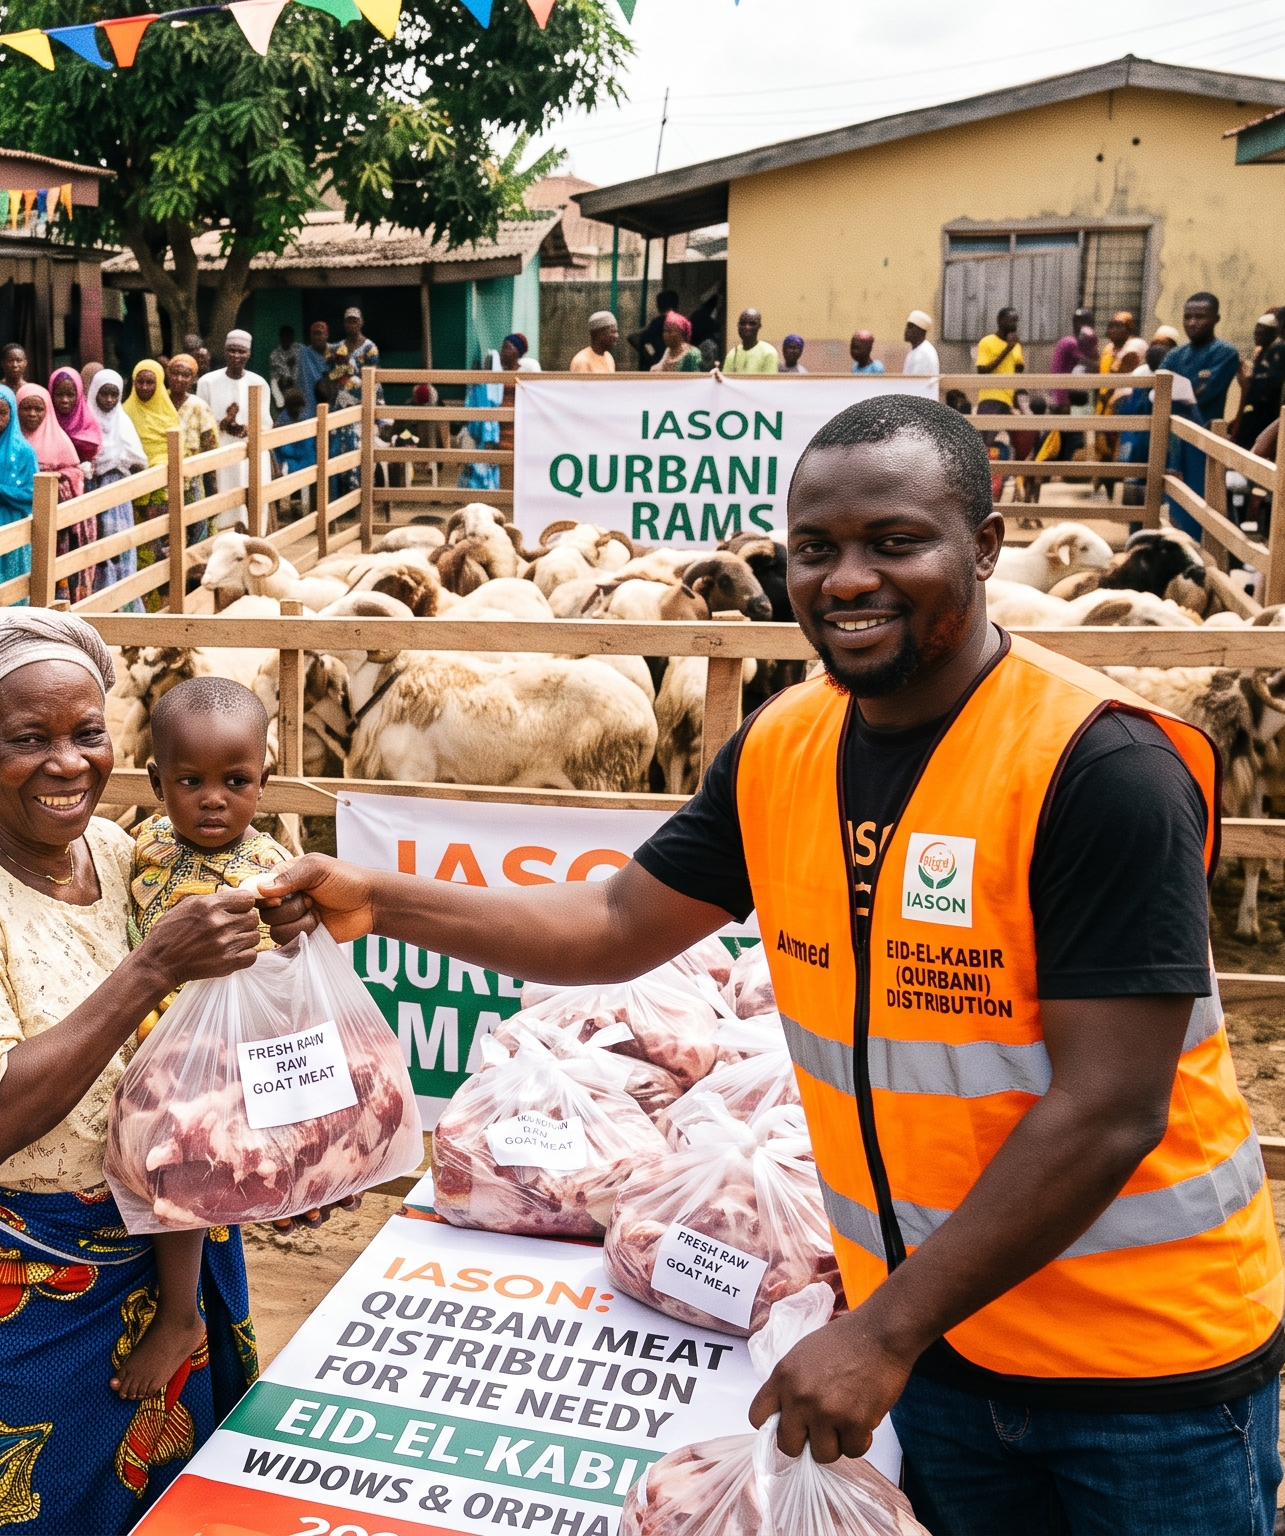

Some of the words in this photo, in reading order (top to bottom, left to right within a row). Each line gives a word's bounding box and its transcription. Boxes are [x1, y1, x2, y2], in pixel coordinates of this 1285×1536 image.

[641, 410, 783, 440] IASON
[549, 453, 778, 498] QURBANI
[632, 501, 774, 541] RAMS
[907, 891, 966, 913] IASON
[887, 940, 1004, 968] EID-EL-KABIR
[896, 965, 991, 996] (QURBANI)
[887, 988, 1012, 1018] DISTRIBUTION
[248, 1042, 294, 1060] FRESH
[276, 1056, 307, 1073] RAW
[253, 1077, 293, 1095] GOAT
[299, 1065, 335, 1087] MEAT
[505, 1136, 537, 1145] GOAT
[540, 1141, 573, 1151] MEAT
[677, 1231, 718, 1257] FRESH
[720, 1250, 749, 1269] RAW
[383, 1257, 615, 1313] IASON:
[666, 1258, 702, 1281] GOAT
[704, 1275, 741, 1298] MEAT
[361, 1291, 583, 1347] QURBANI
[592, 1326, 734, 1371] MEAT
[336, 1321, 698, 1405] DISTRIBUTION
[315, 1355, 408, 1393] FOR
[419, 1371, 508, 1411] THE
[515, 1388, 675, 1439] NEEDY
[275, 1398, 646, 1496] EID-EL-KABI
[242, 1448, 414, 1504] WIDOWS
[418, 1484, 453, 1514] &
[462, 1491, 620, 1536] ORPHA
